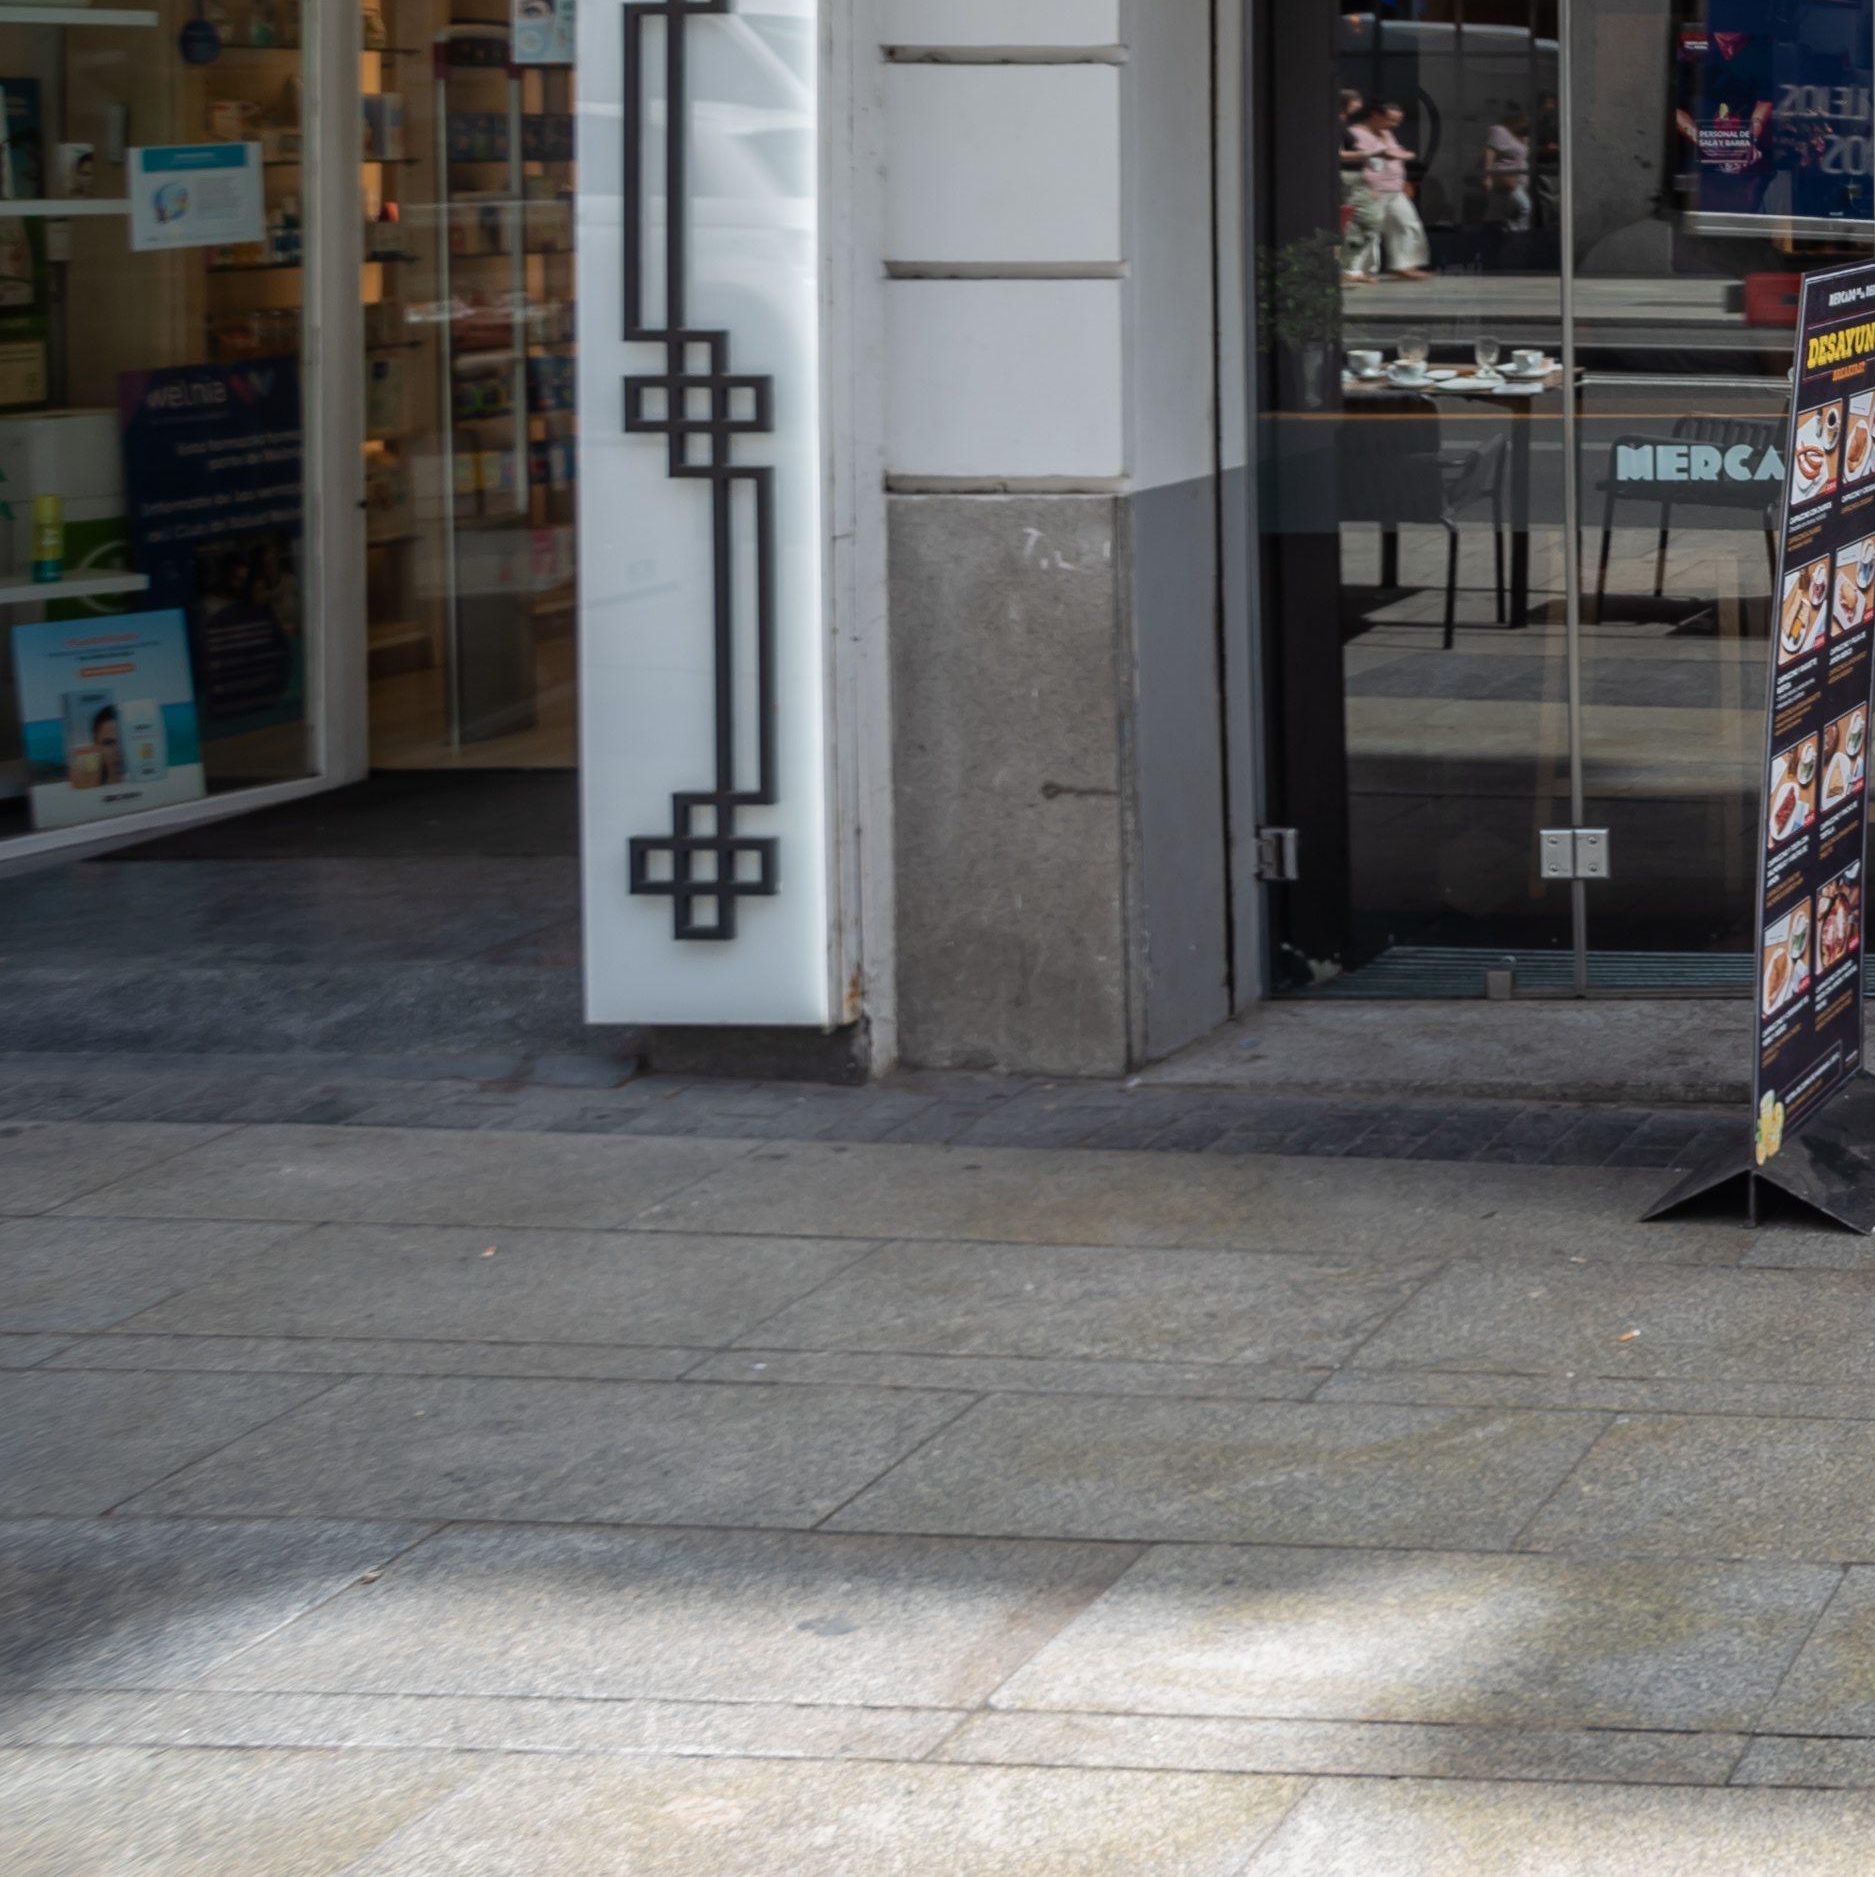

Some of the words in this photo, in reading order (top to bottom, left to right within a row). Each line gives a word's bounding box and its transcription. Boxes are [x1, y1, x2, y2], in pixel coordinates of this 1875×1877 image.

[1699, 130, 1738, 138] PERSONAL
[1739, 130, 1750, 138] DE
[1699, 139, 1718, 147] SALA
[1725, 139, 1751, 147] BARRA
[1616, 444, 1786, 481] MERCA
